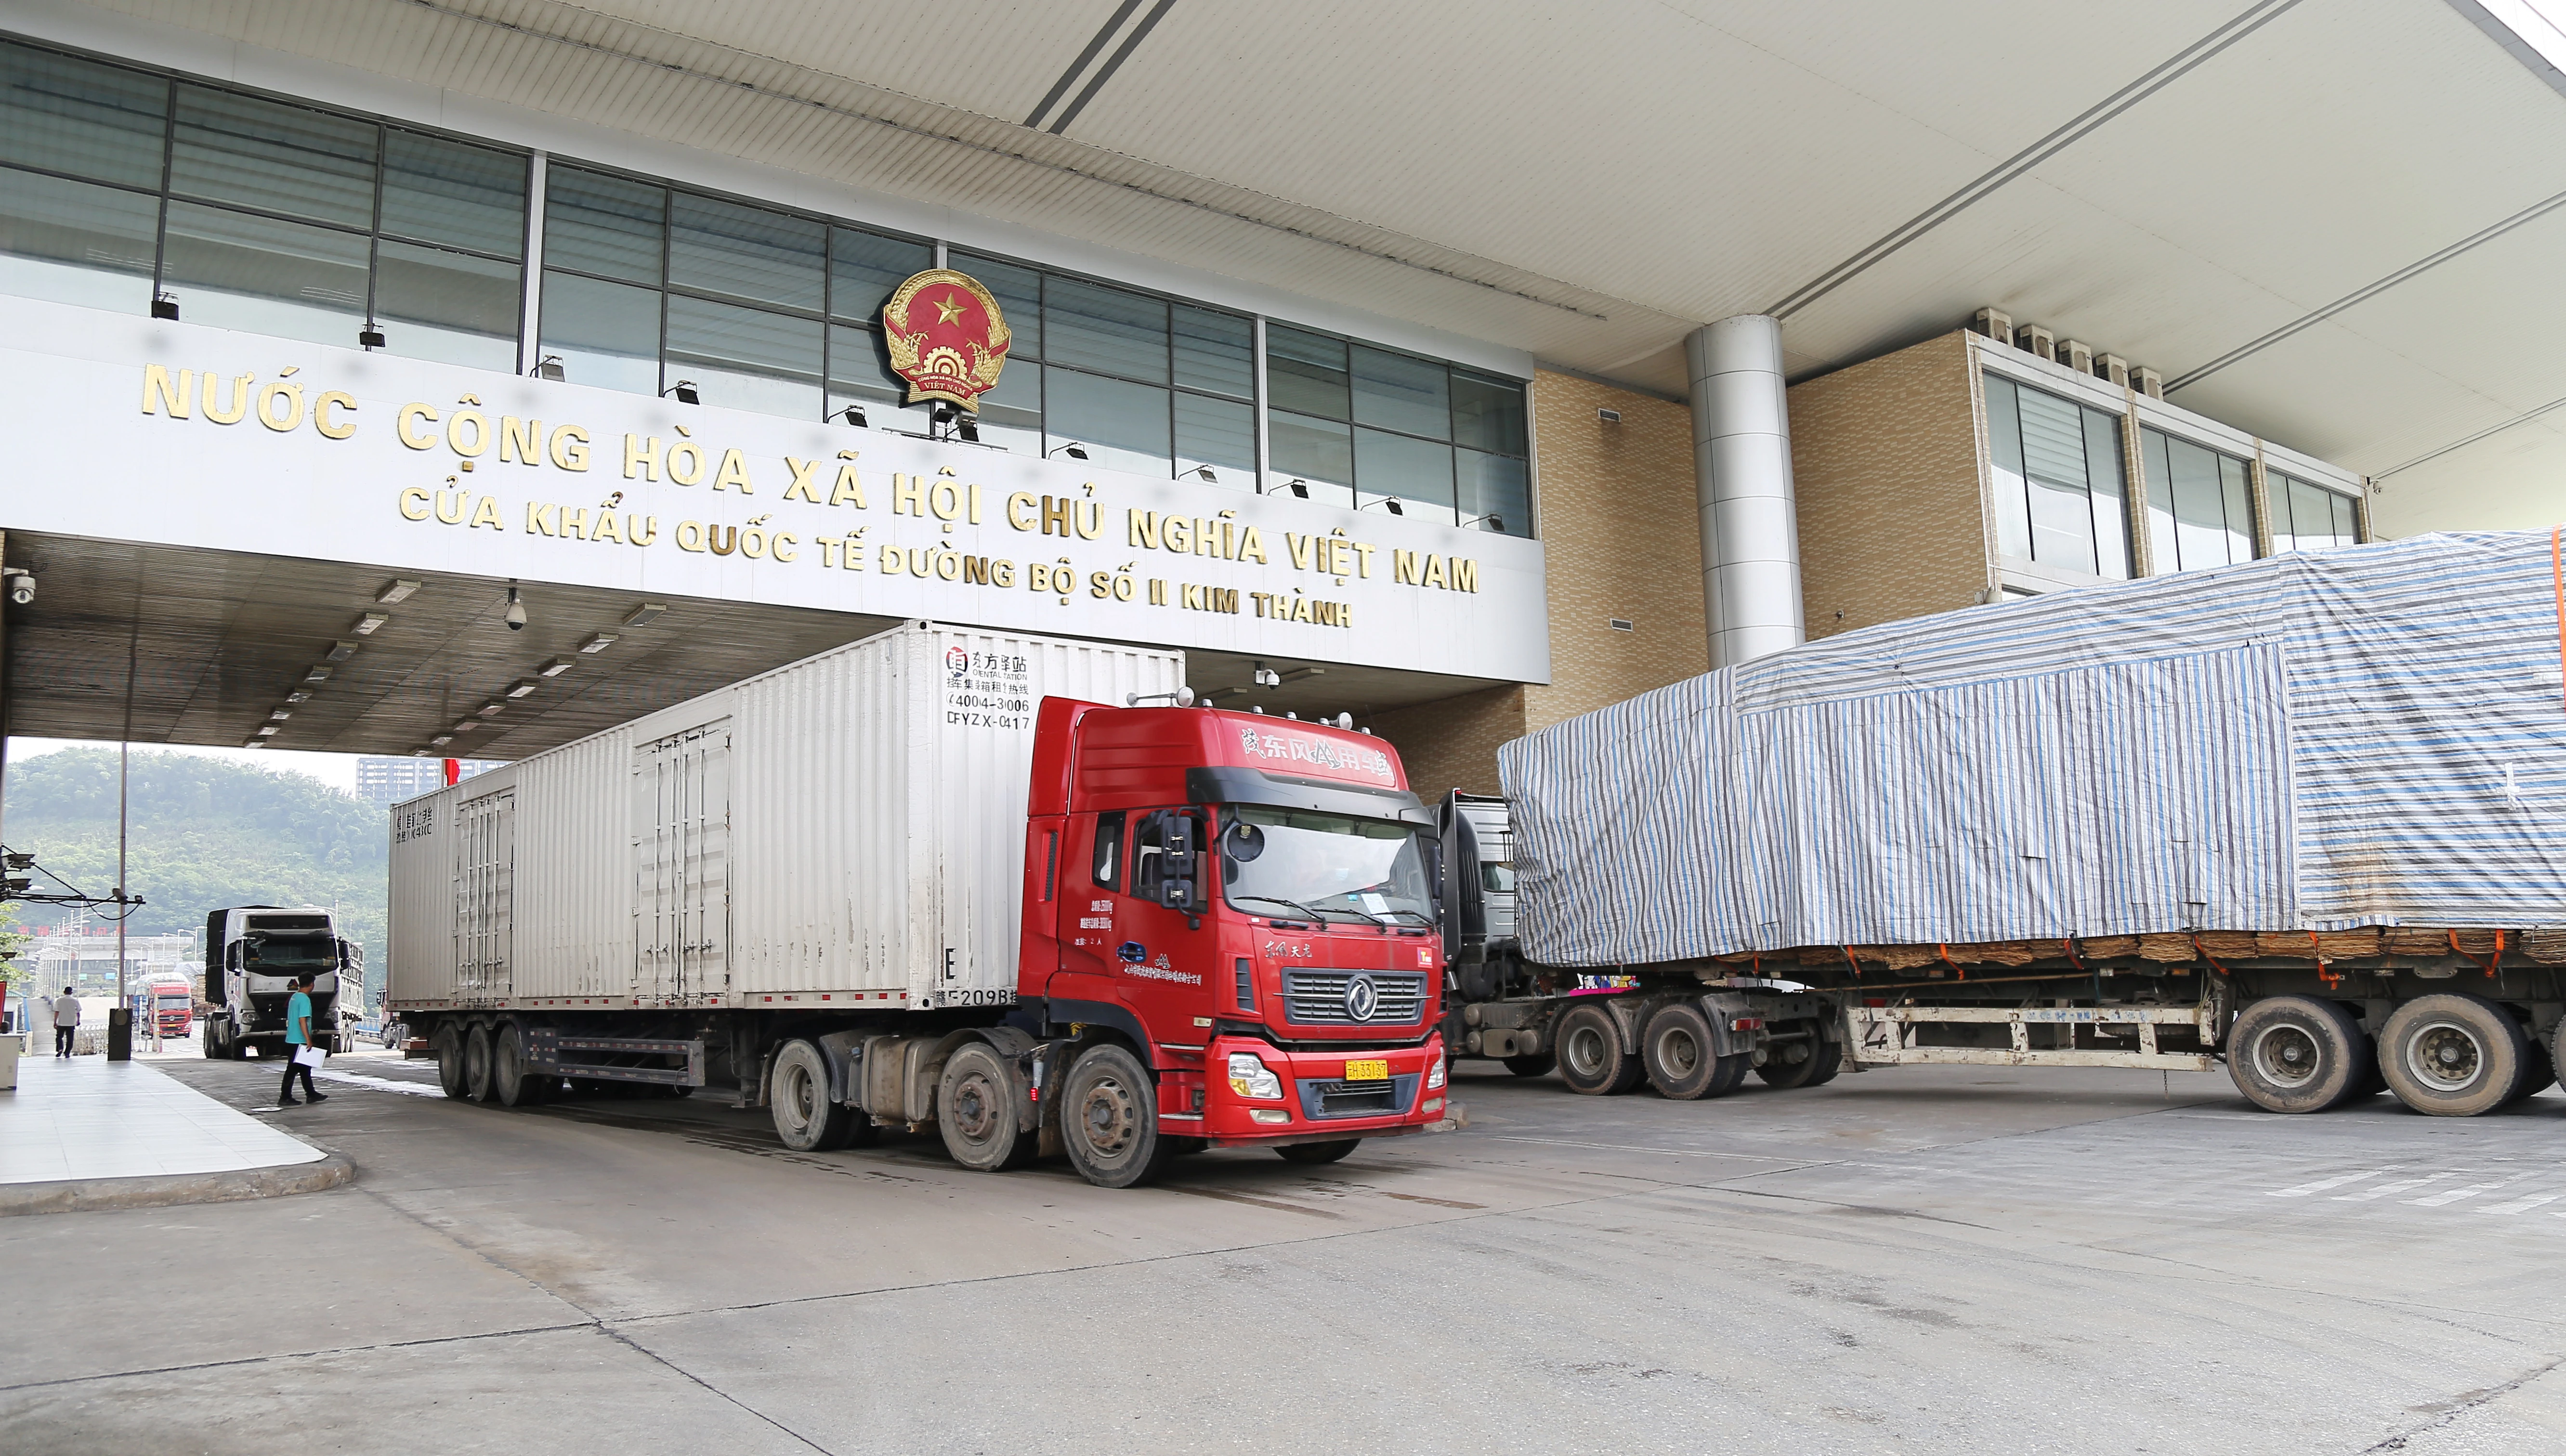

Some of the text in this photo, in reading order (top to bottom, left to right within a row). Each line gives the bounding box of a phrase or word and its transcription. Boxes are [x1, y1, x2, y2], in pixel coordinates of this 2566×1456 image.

[947, 384, 966, 395] NAM
[143, 365, 1479, 593] NƯỚC CỘNG HÒA XÃ HỘI CHỦ NGHĨA VIỆT NAM
[400, 476, 1352, 627] CỬA KHẨU QUỐC TẾ ĐƯỜNG BỘ SỐ II KIM THÀNH
